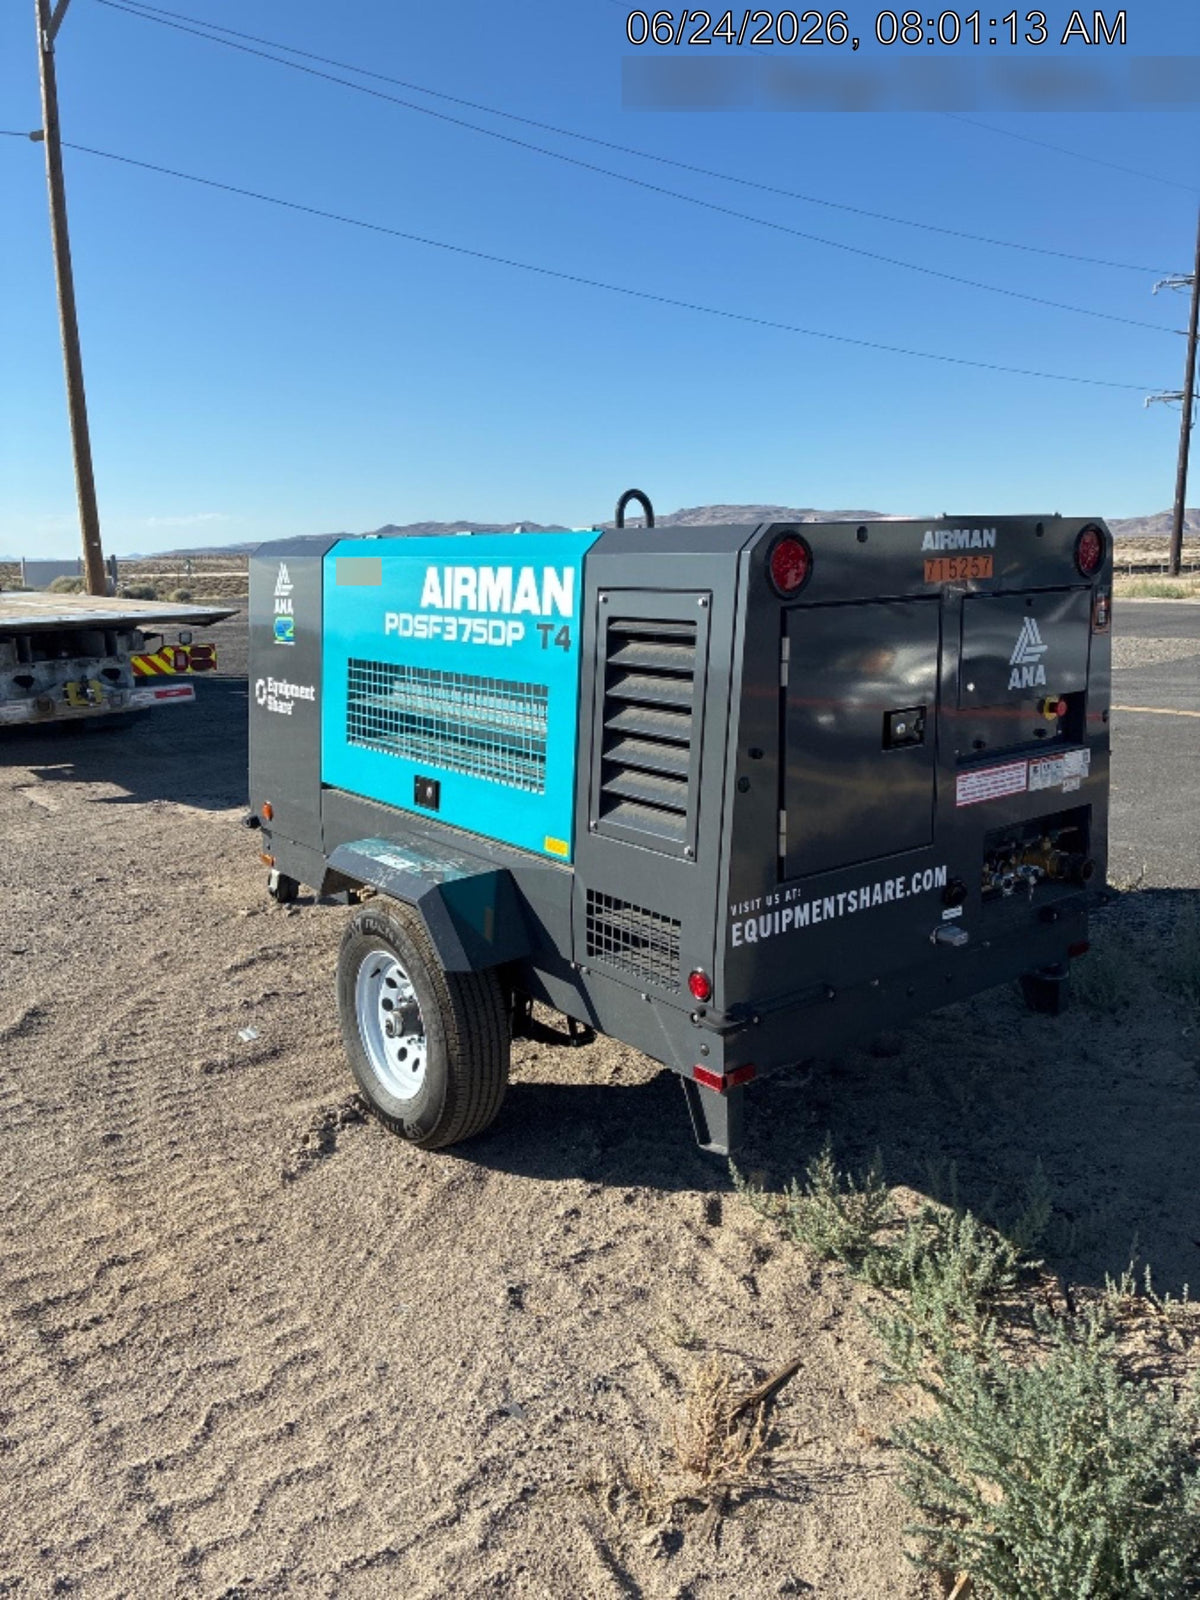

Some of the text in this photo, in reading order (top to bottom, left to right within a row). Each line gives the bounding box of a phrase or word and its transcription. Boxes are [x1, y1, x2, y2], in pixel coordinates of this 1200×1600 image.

[921, 528, 997, 551] AIRMAN
[926, 556, 993, 581] 715257
[420, 566, 575, 617] AIRMAN
[273, 598, 294, 615] ANA
[384, 612, 571, 652] PDSF375DP T4
[267, 677, 315, 701] Equipment
[1008, 664, 1046, 690] ANA
[730, 888, 801, 917] VISIT US AT:
[731, 865, 948, 948] EQUIPMENTSHARE.COM
